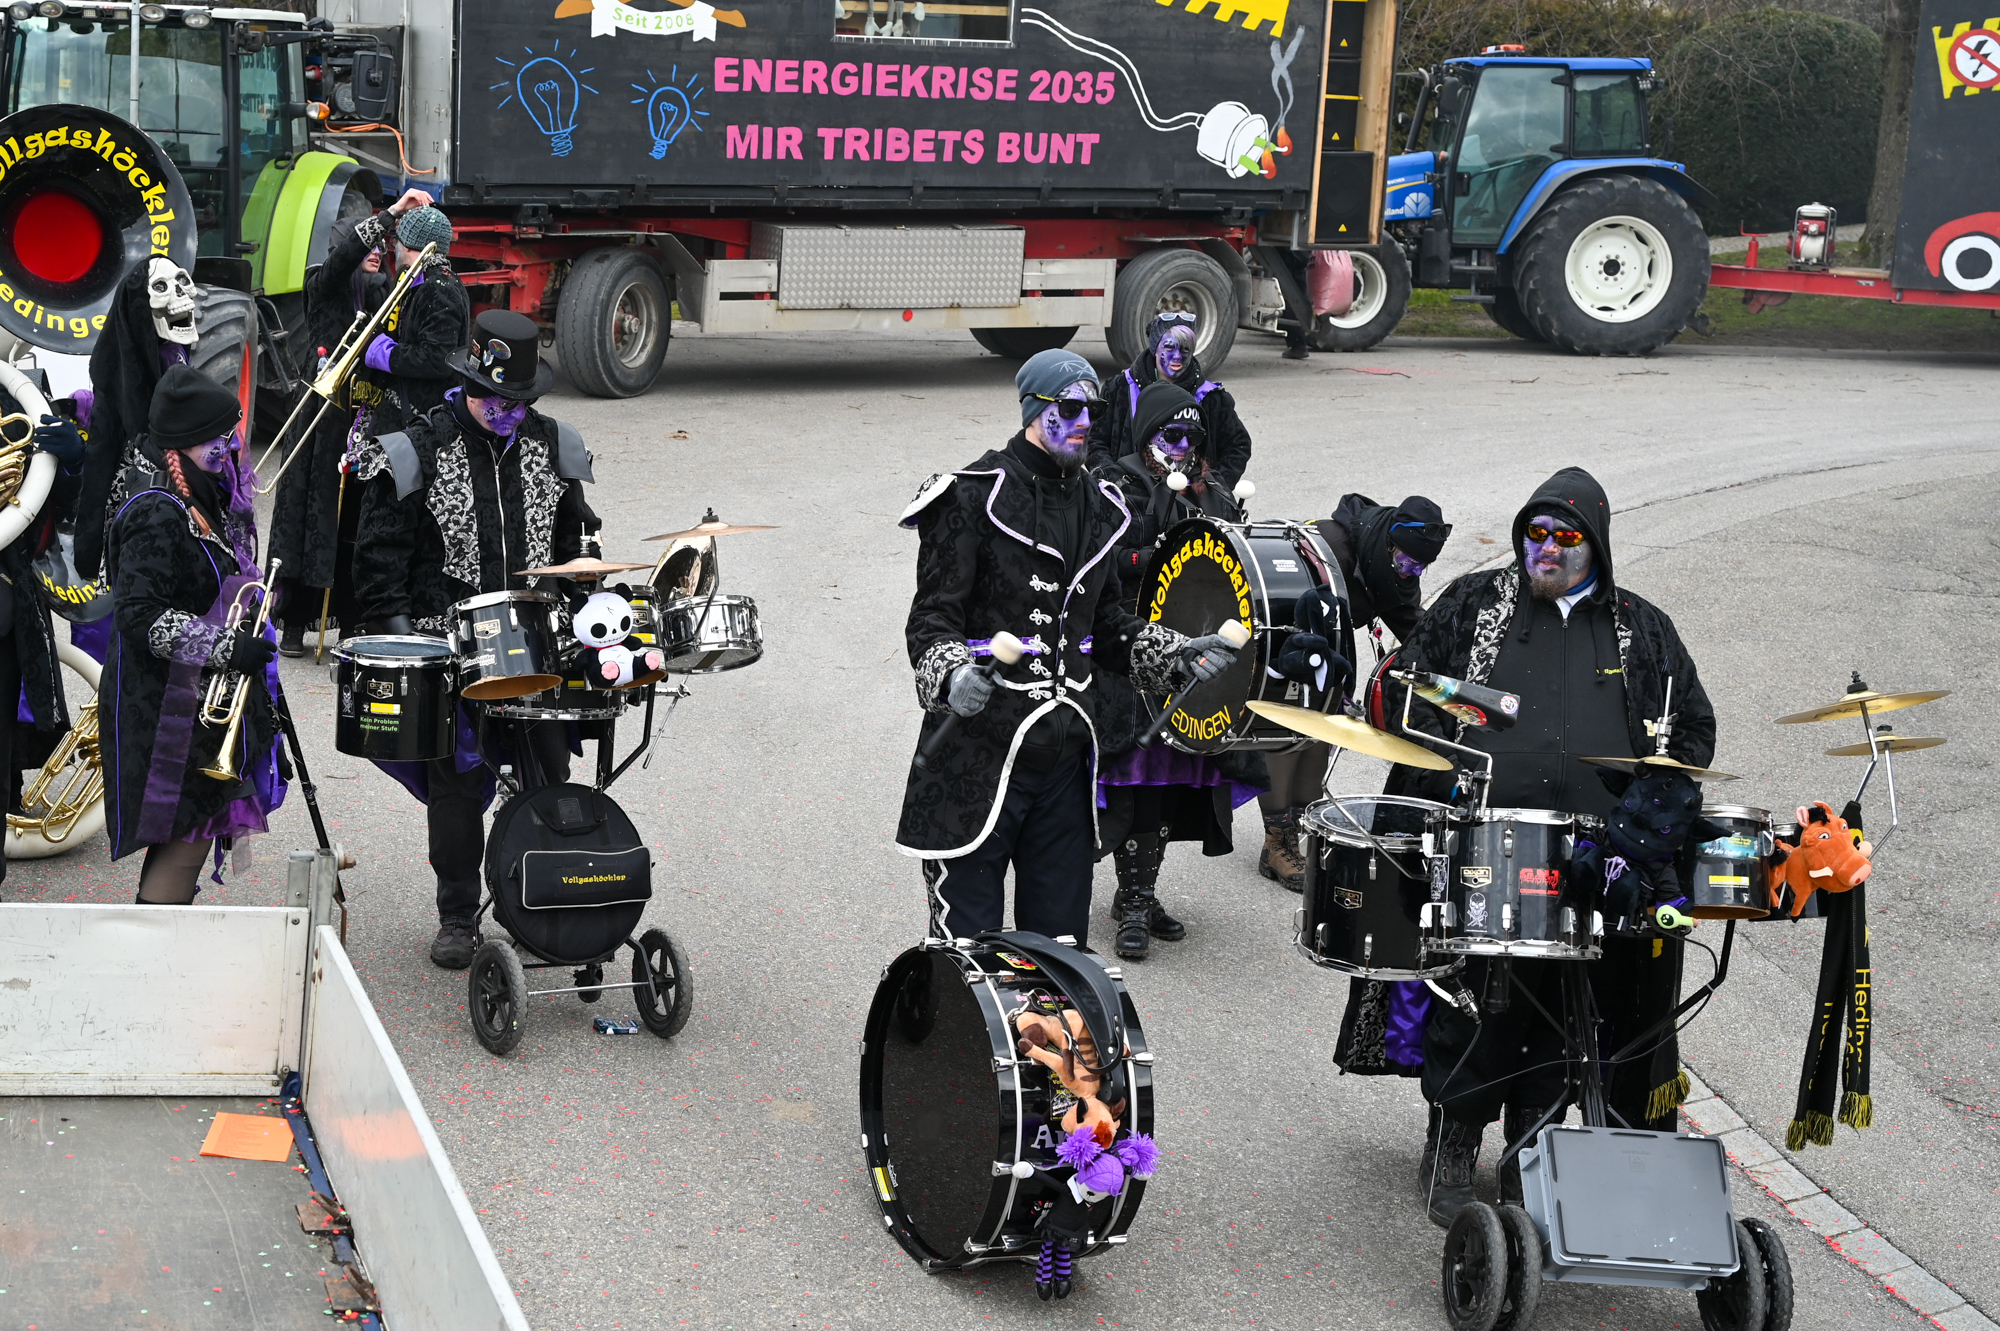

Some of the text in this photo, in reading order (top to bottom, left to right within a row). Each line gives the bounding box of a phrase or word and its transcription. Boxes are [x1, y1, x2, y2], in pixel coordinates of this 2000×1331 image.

[612, 7, 694, 30] Seit 2008
[714, 56, 1116, 105] ENERGIEKRISE 2035
[726, 123, 1101, 166] MIR TRIBETS BUNT
[0, 269, 108, 338] edinge
[374, 717, 400, 725] Problem
[562, 873, 627, 885] Vollgashöckler
